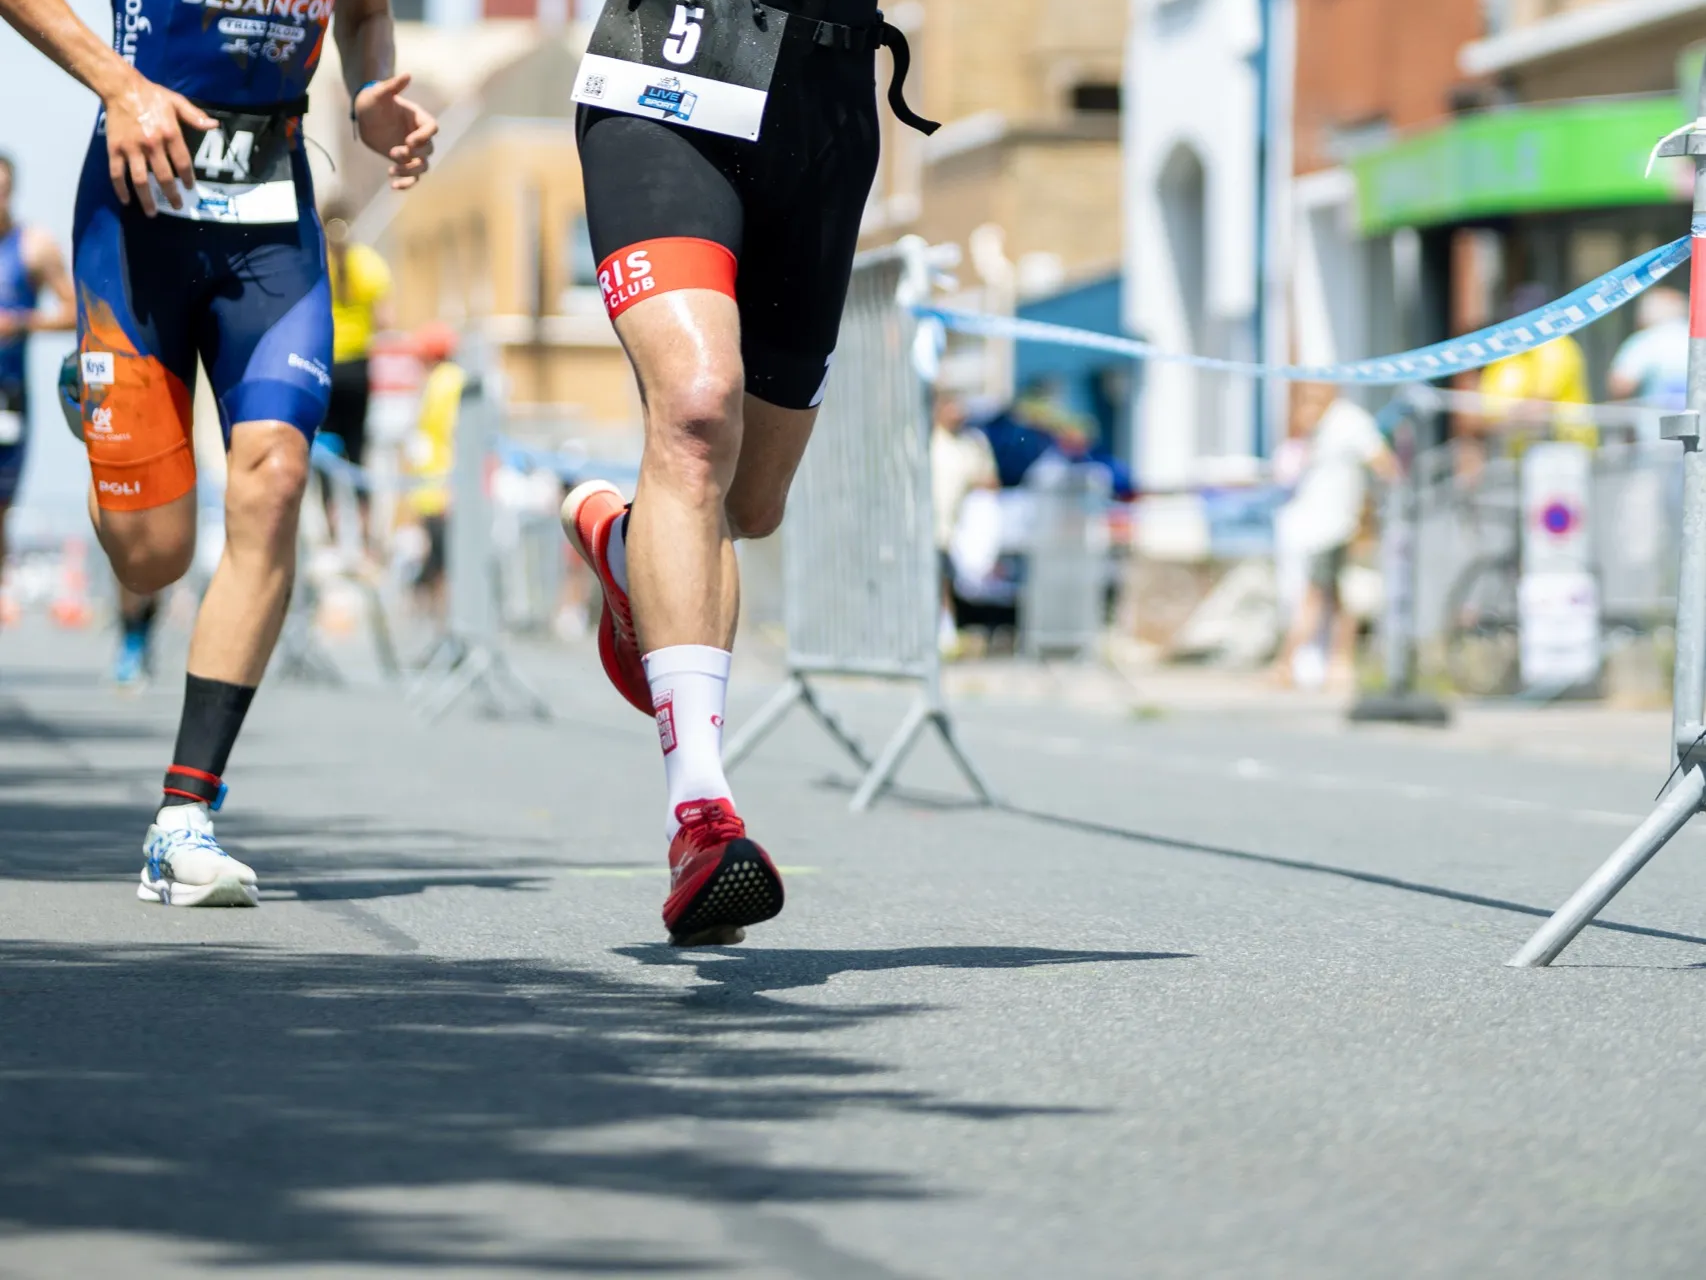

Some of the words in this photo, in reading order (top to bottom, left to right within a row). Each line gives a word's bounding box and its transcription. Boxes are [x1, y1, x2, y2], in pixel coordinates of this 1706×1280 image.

[662, 4, 704, 65] 5
[648, 87, 681, 102] LIVE
[194, 128, 255, 182] 44
[610, 276, 656, 308] CLUB
[85, 359, 106, 376] Krys
